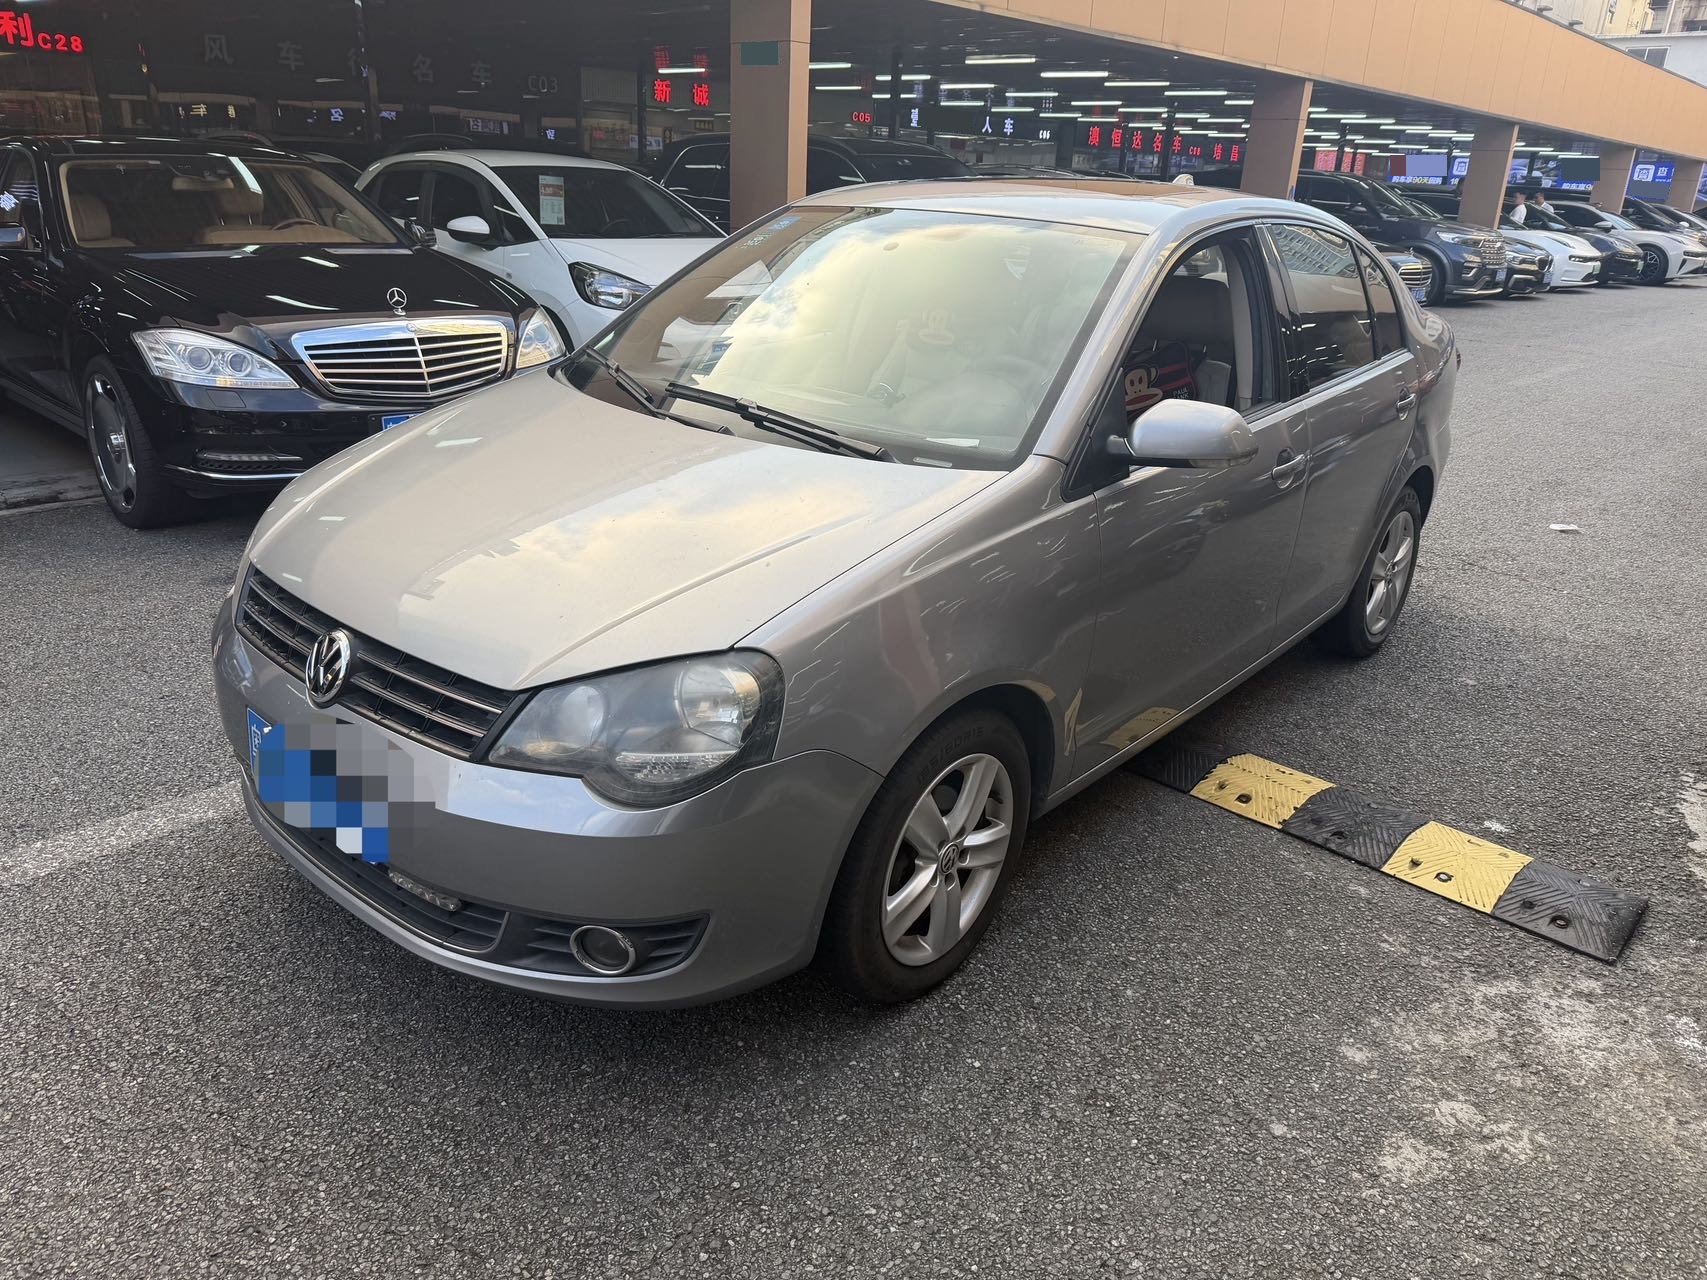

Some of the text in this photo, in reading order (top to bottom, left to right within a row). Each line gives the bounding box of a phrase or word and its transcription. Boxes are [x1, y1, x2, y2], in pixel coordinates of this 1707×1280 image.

[37, 32, 84, 52] C28
[527, 75, 560, 94] C03
[852, 111, 871, 123] C05
[1088, 126, 1182, 153] 澳恒达名车
